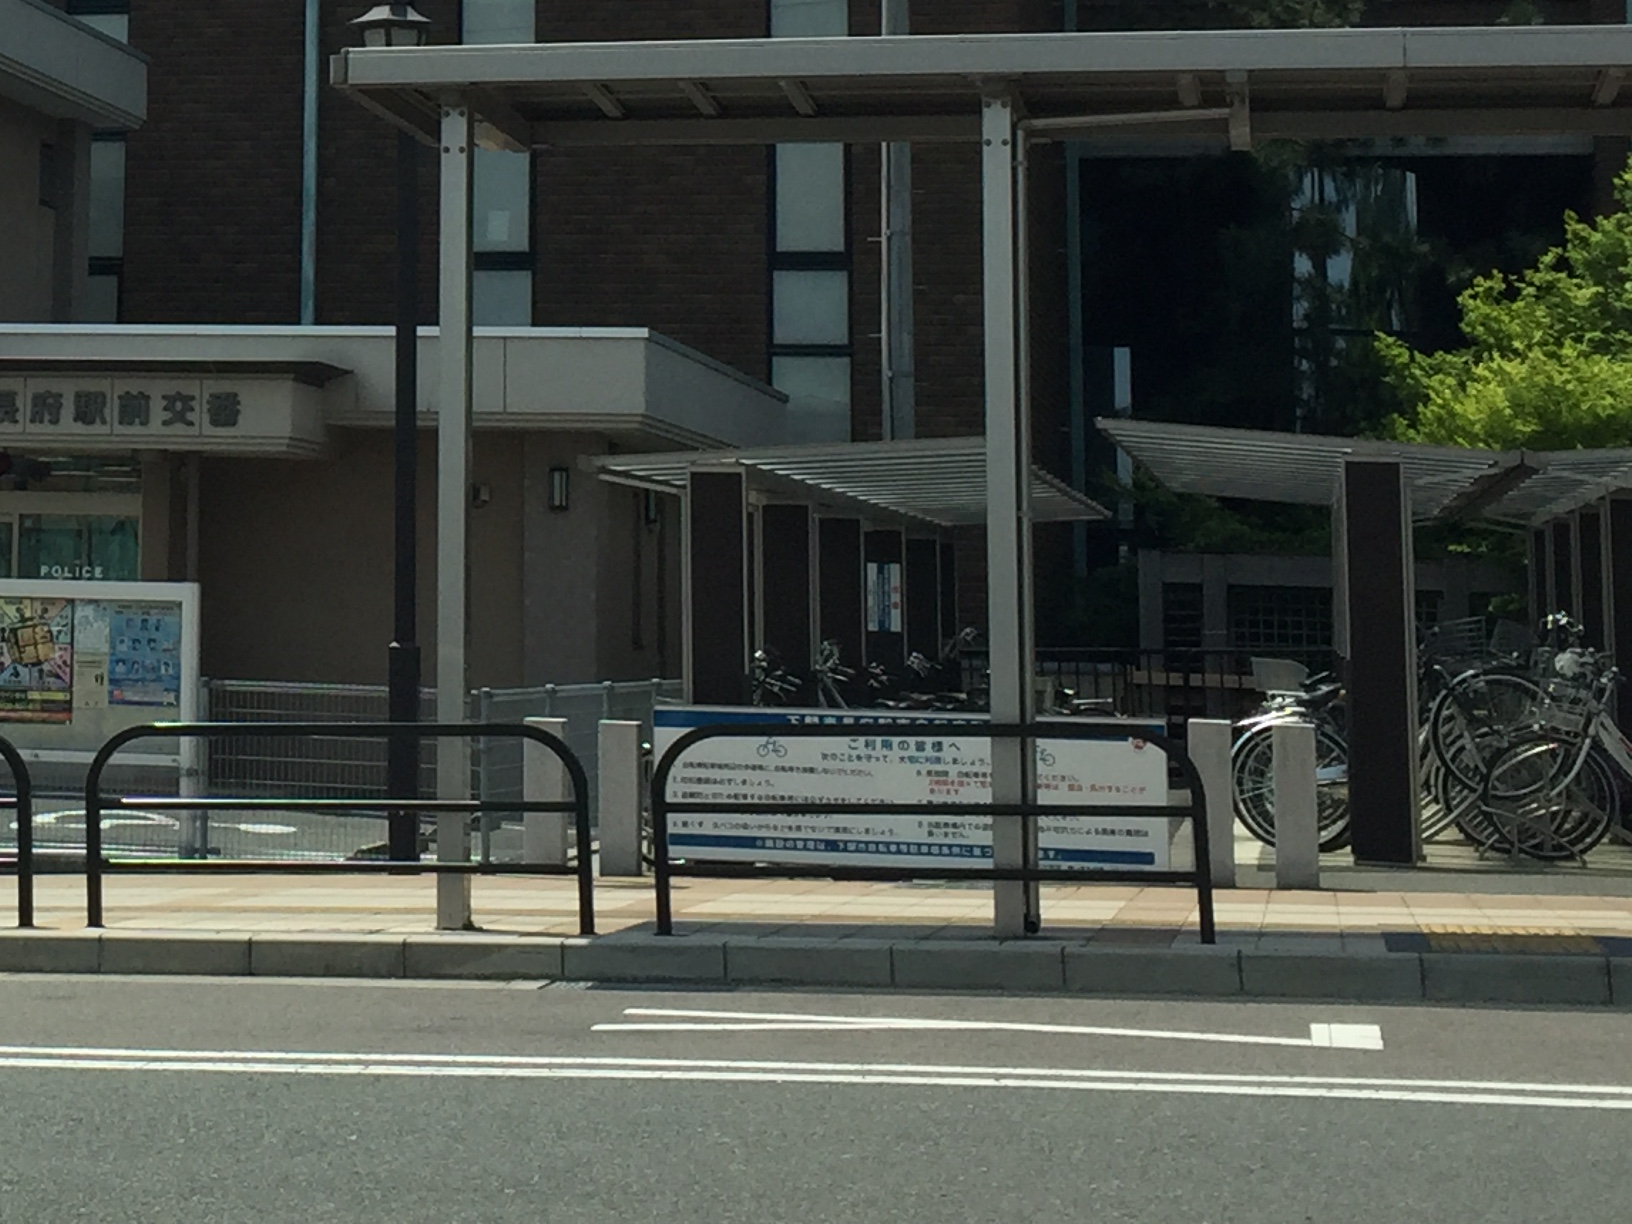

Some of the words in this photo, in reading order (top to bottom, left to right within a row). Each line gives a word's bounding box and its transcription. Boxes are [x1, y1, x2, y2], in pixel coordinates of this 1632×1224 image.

[40, 564, 104, 579] POLICE
[847, 738, 962, 753] ご利用の皆様へ
